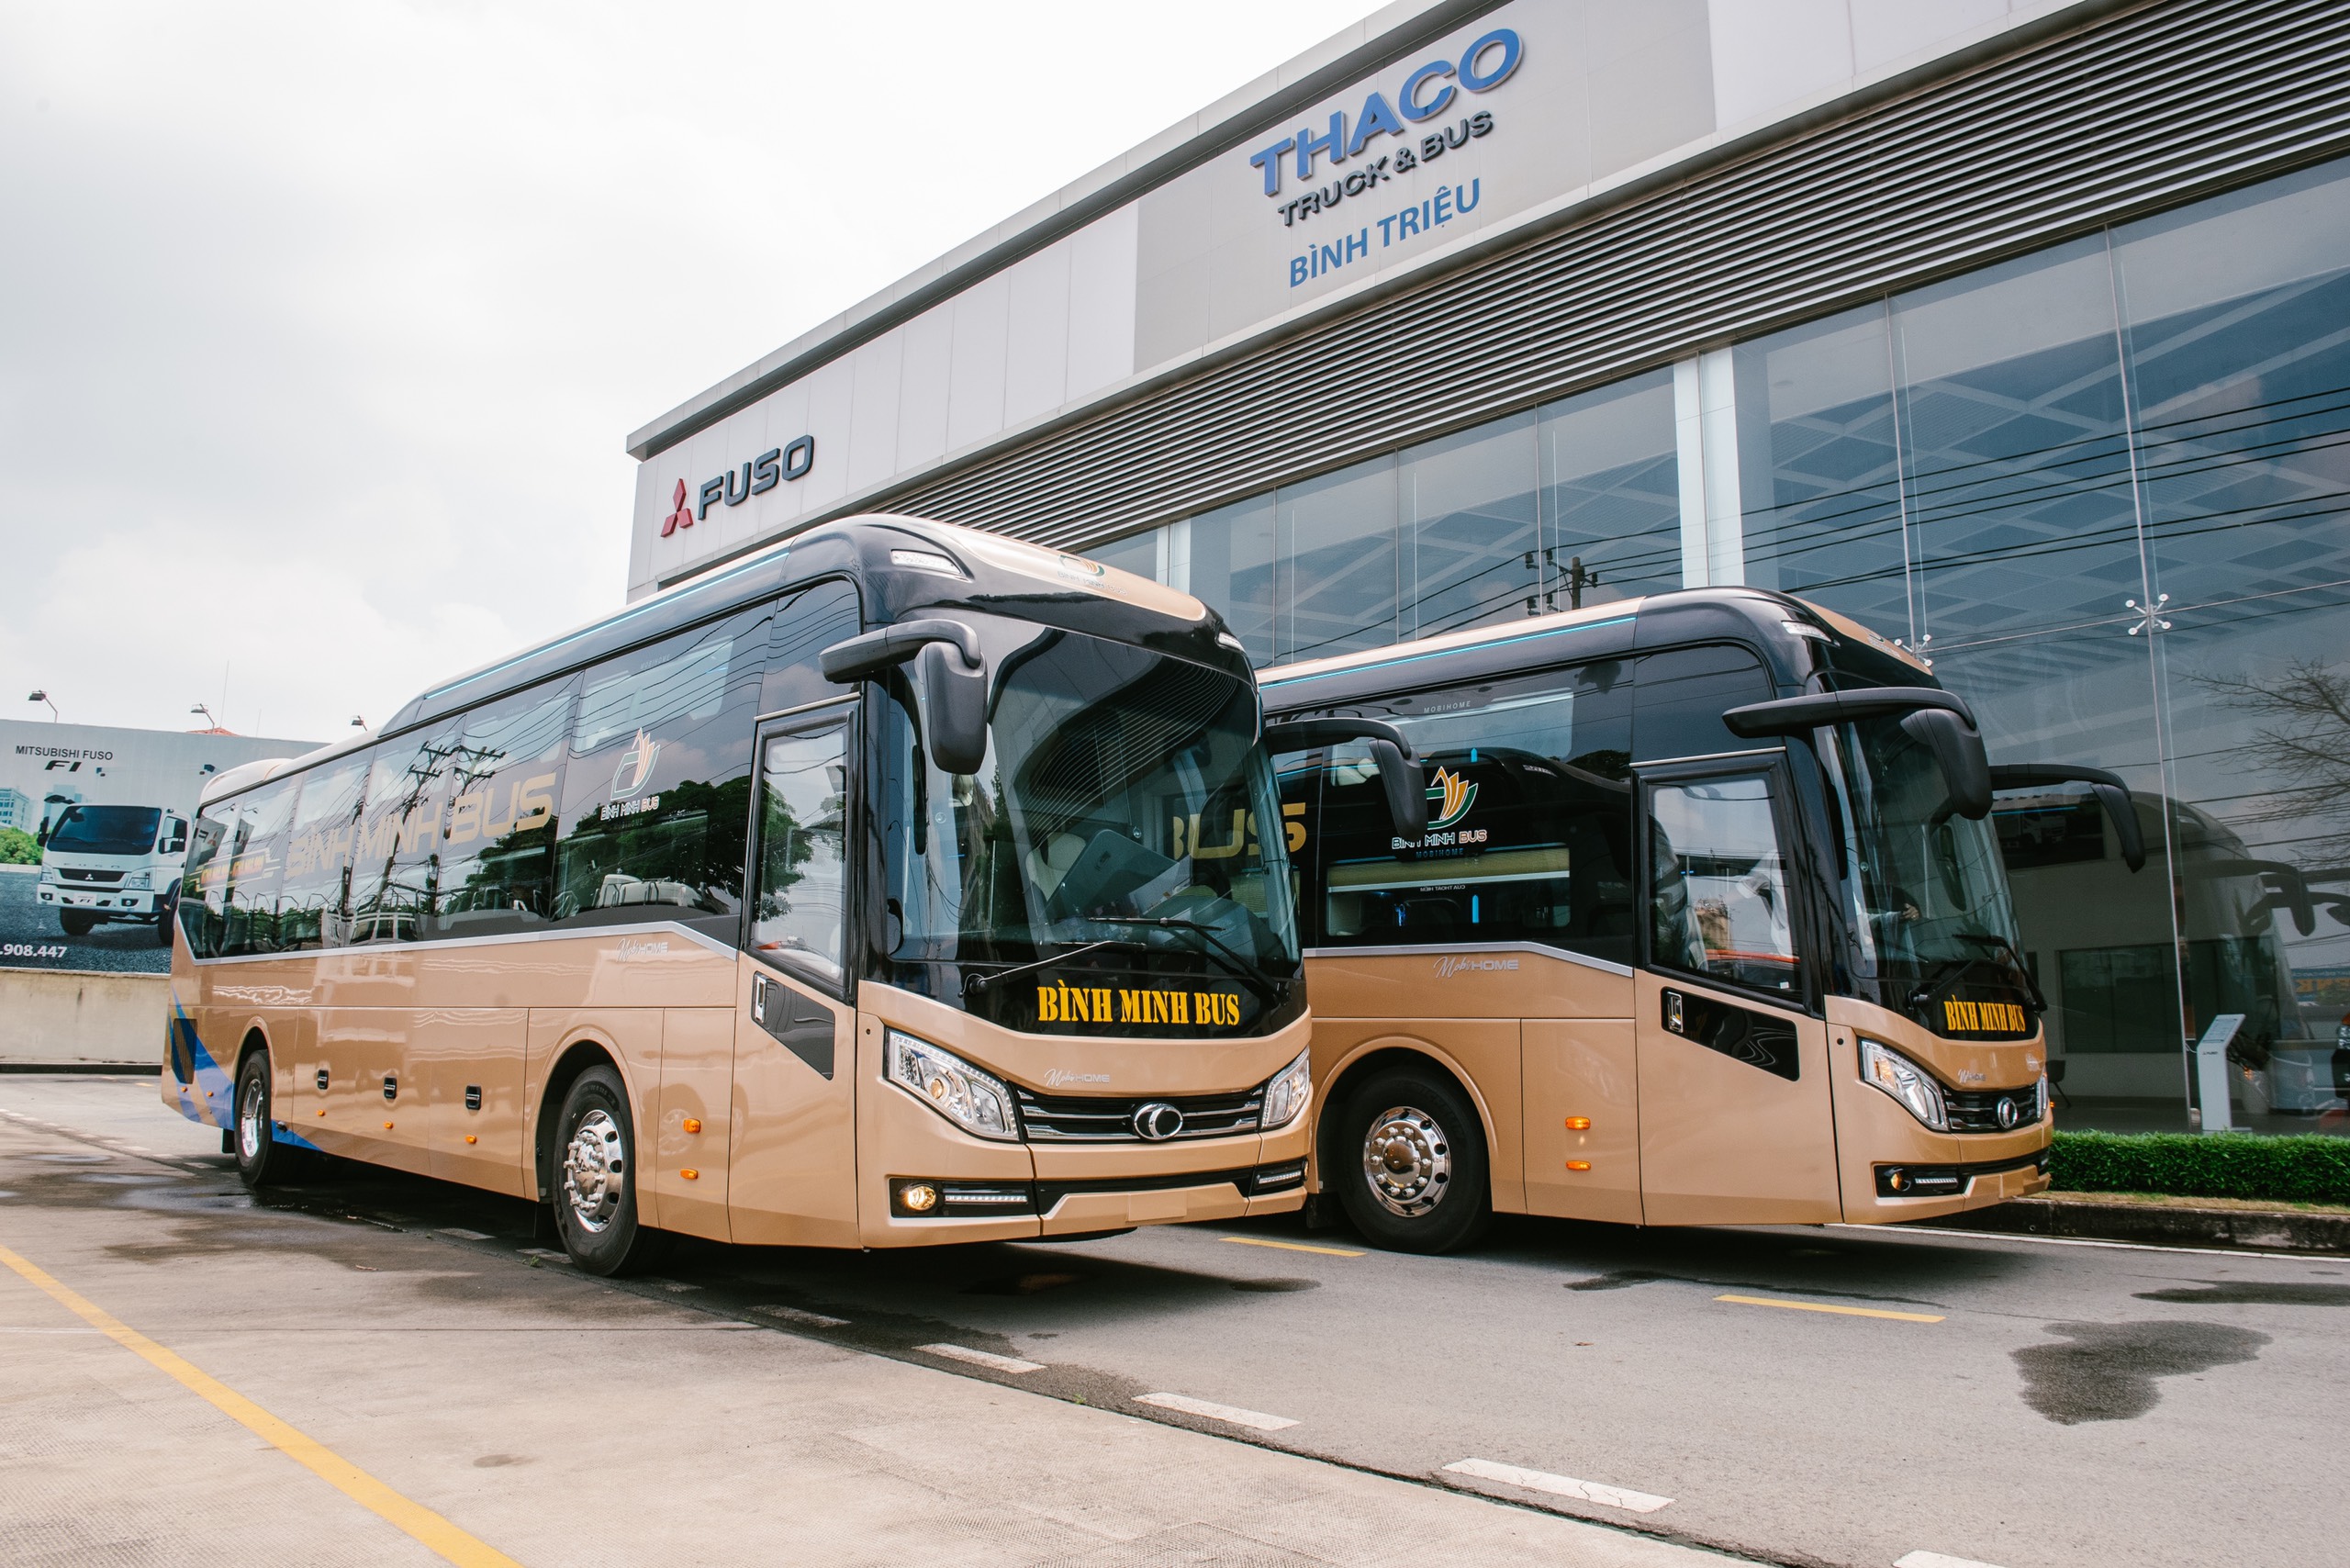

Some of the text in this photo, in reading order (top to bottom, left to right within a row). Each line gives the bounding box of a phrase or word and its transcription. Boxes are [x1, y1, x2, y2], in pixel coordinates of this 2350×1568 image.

[1250, 28, 1524, 196] THACO
[1277, 110, 1493, 227] TRUCK & BUS
[1290, 177, 1481, 288] BÌNH TRIỆU
[698, 434, 814, 521] FUSO
[1424, 700, 1471, 713] MOBIHOME
[16, 745, 113, 761] MITSUBISHI FUSO
[45, 760, 82, 772] FI
[355, 801, 443, 865] MINH
[448, 772, 556, 846] BUS
[641, 796, 660, 812] BUS
[1416, 848, 1464, 858] MOBIHOME
[1425, 832, 1456, 846] MINH
[1459, 829, 1487, 844] BUS
[1037, 980, 1240, 1025] BÌNH MINH BUS
[1944, 994, 2025, 1032] BÌNH MINH BUS
